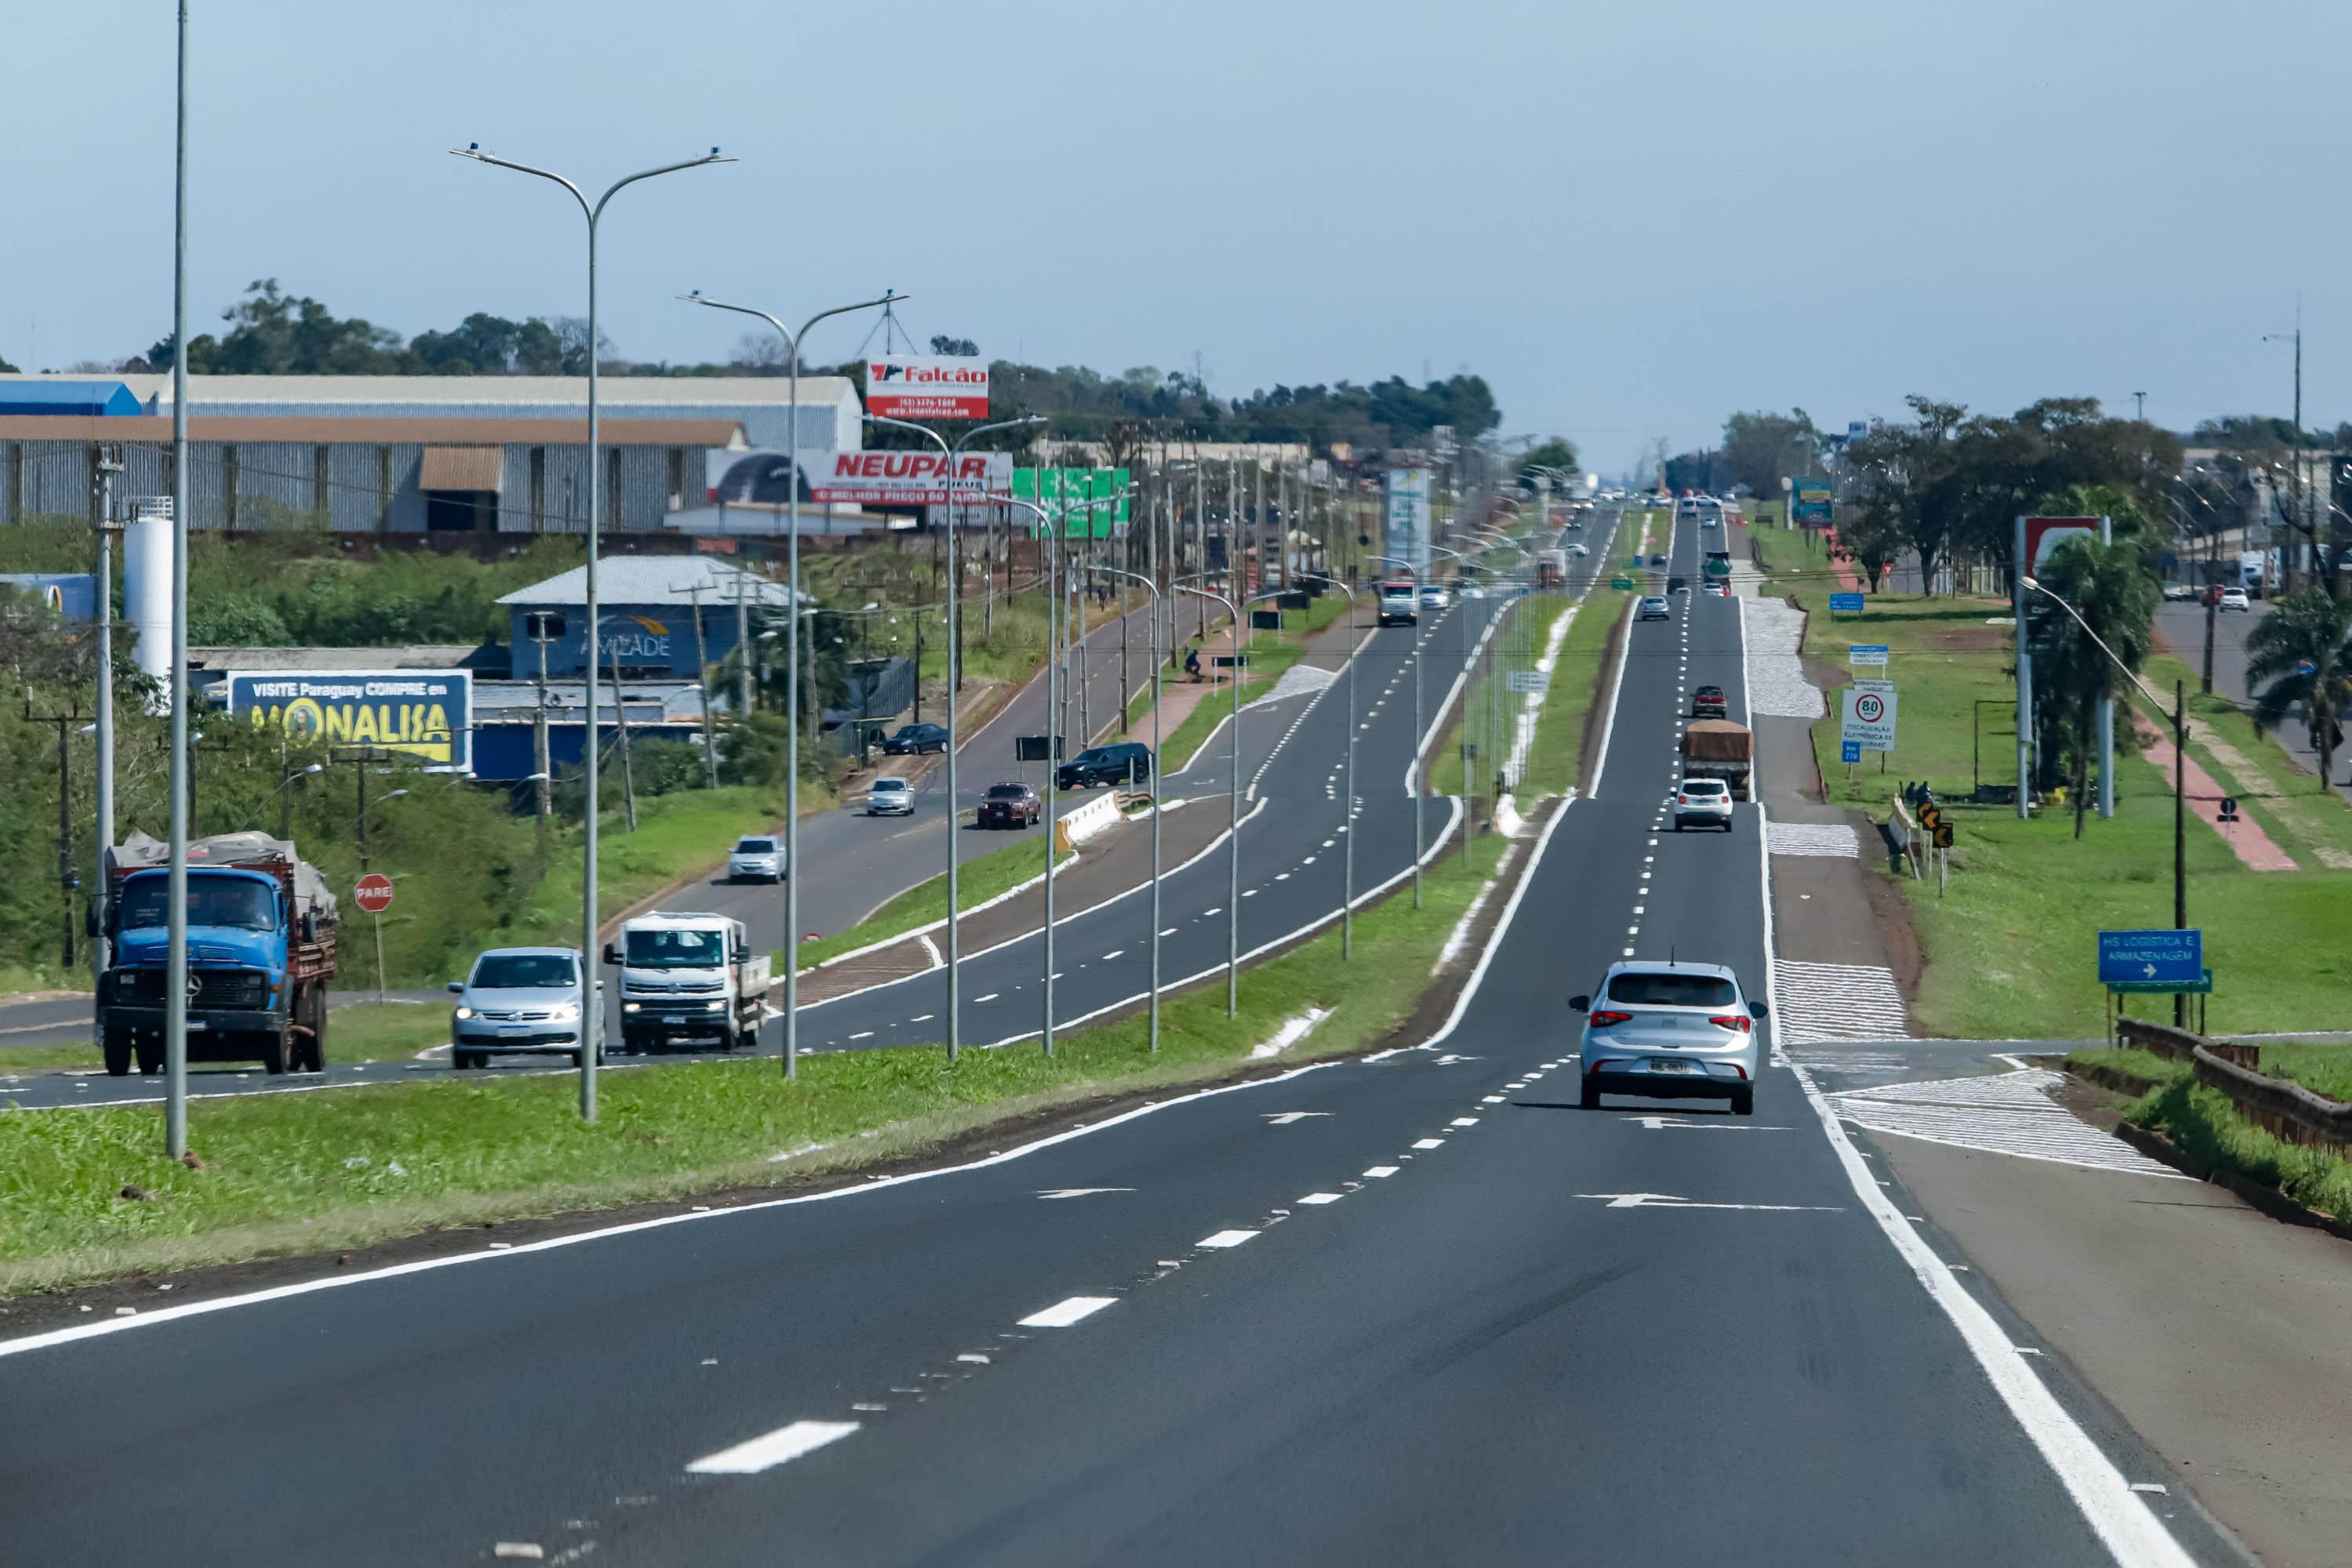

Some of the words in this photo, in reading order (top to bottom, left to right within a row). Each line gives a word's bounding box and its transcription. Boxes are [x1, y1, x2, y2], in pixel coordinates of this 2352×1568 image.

[906, 366, 986, 383] Falcão
[835, 454, 987, 480] NEUPAR
[252, 682, 298, 697] VISITE
[300, 683, 365, 699] Paraguay
[365, 682, 427, 695] COMPRE
[428, 684, 447, 695] en
[1862, 700, 1878, 713] 80
[357, 887, 392, 899] PARE
[2103, 936, 2120, 947] HS
[2186, 936, 2194, 946] E
[2107, 950, 2193, 961] ARMAZENAGEM
